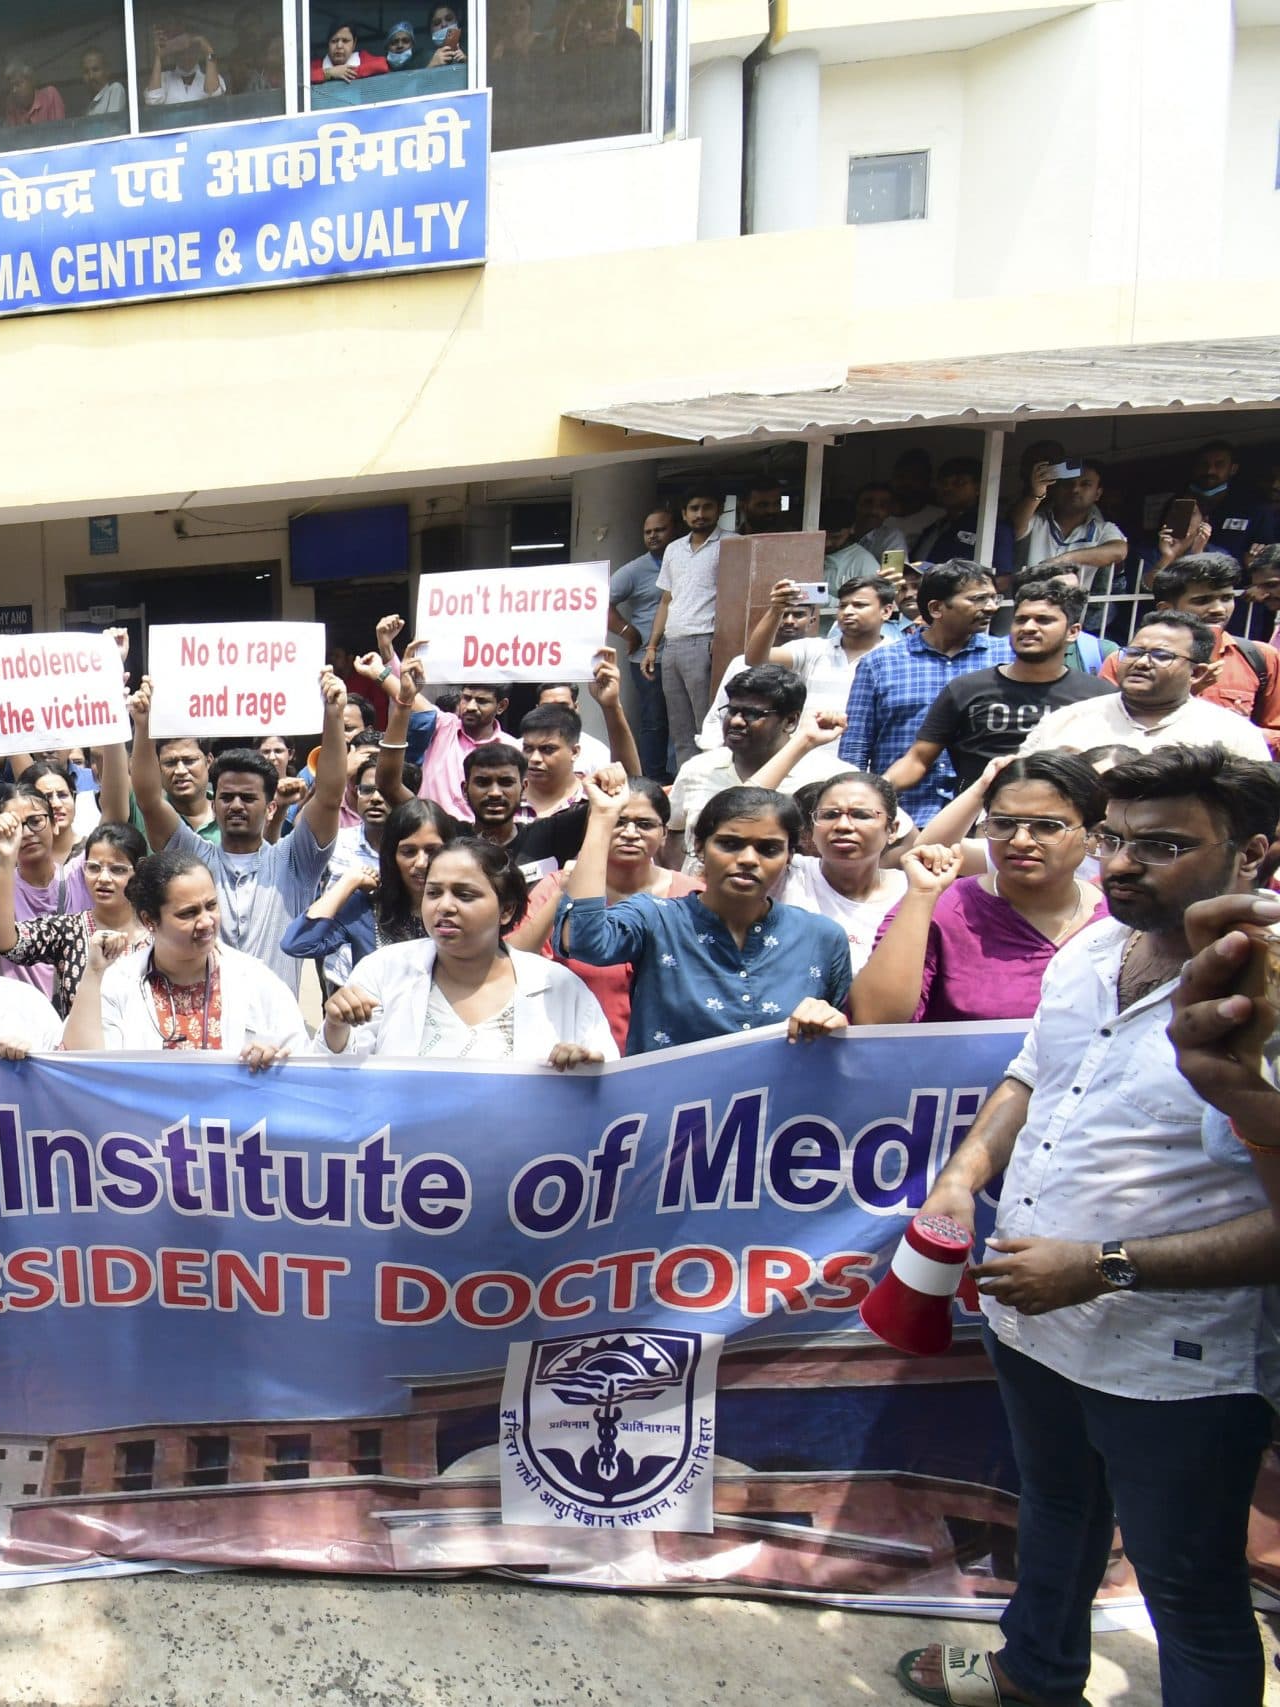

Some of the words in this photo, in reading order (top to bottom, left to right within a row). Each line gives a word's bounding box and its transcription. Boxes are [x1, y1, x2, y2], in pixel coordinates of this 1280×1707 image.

[111, 142, 189, 208] एवं
[206, 107, 471, 198] आकस्मिकी
[50, 231, 202, 296] CENTRE
[215, 227, 242, 278] &
[255, 199, 469, 272] CASUALTY
[10, 610, 28, 624] AND
[428, 585, 490, 617] Don't
[499, 584, 598, 614] harrass
[181, 637, 210, 666] No
[217, 639, 239, 665] to
[246, 640, 297, 671] rape
[463, 635, 562, 668] Doctors
[41, 696, 118, 730] victim.
[188, 686, 228, 718] and
[235, 689, 287, 725] rage
[508, 1113, 648, 1239] of
[375, 1245, 876, 1329] DOCTORS
